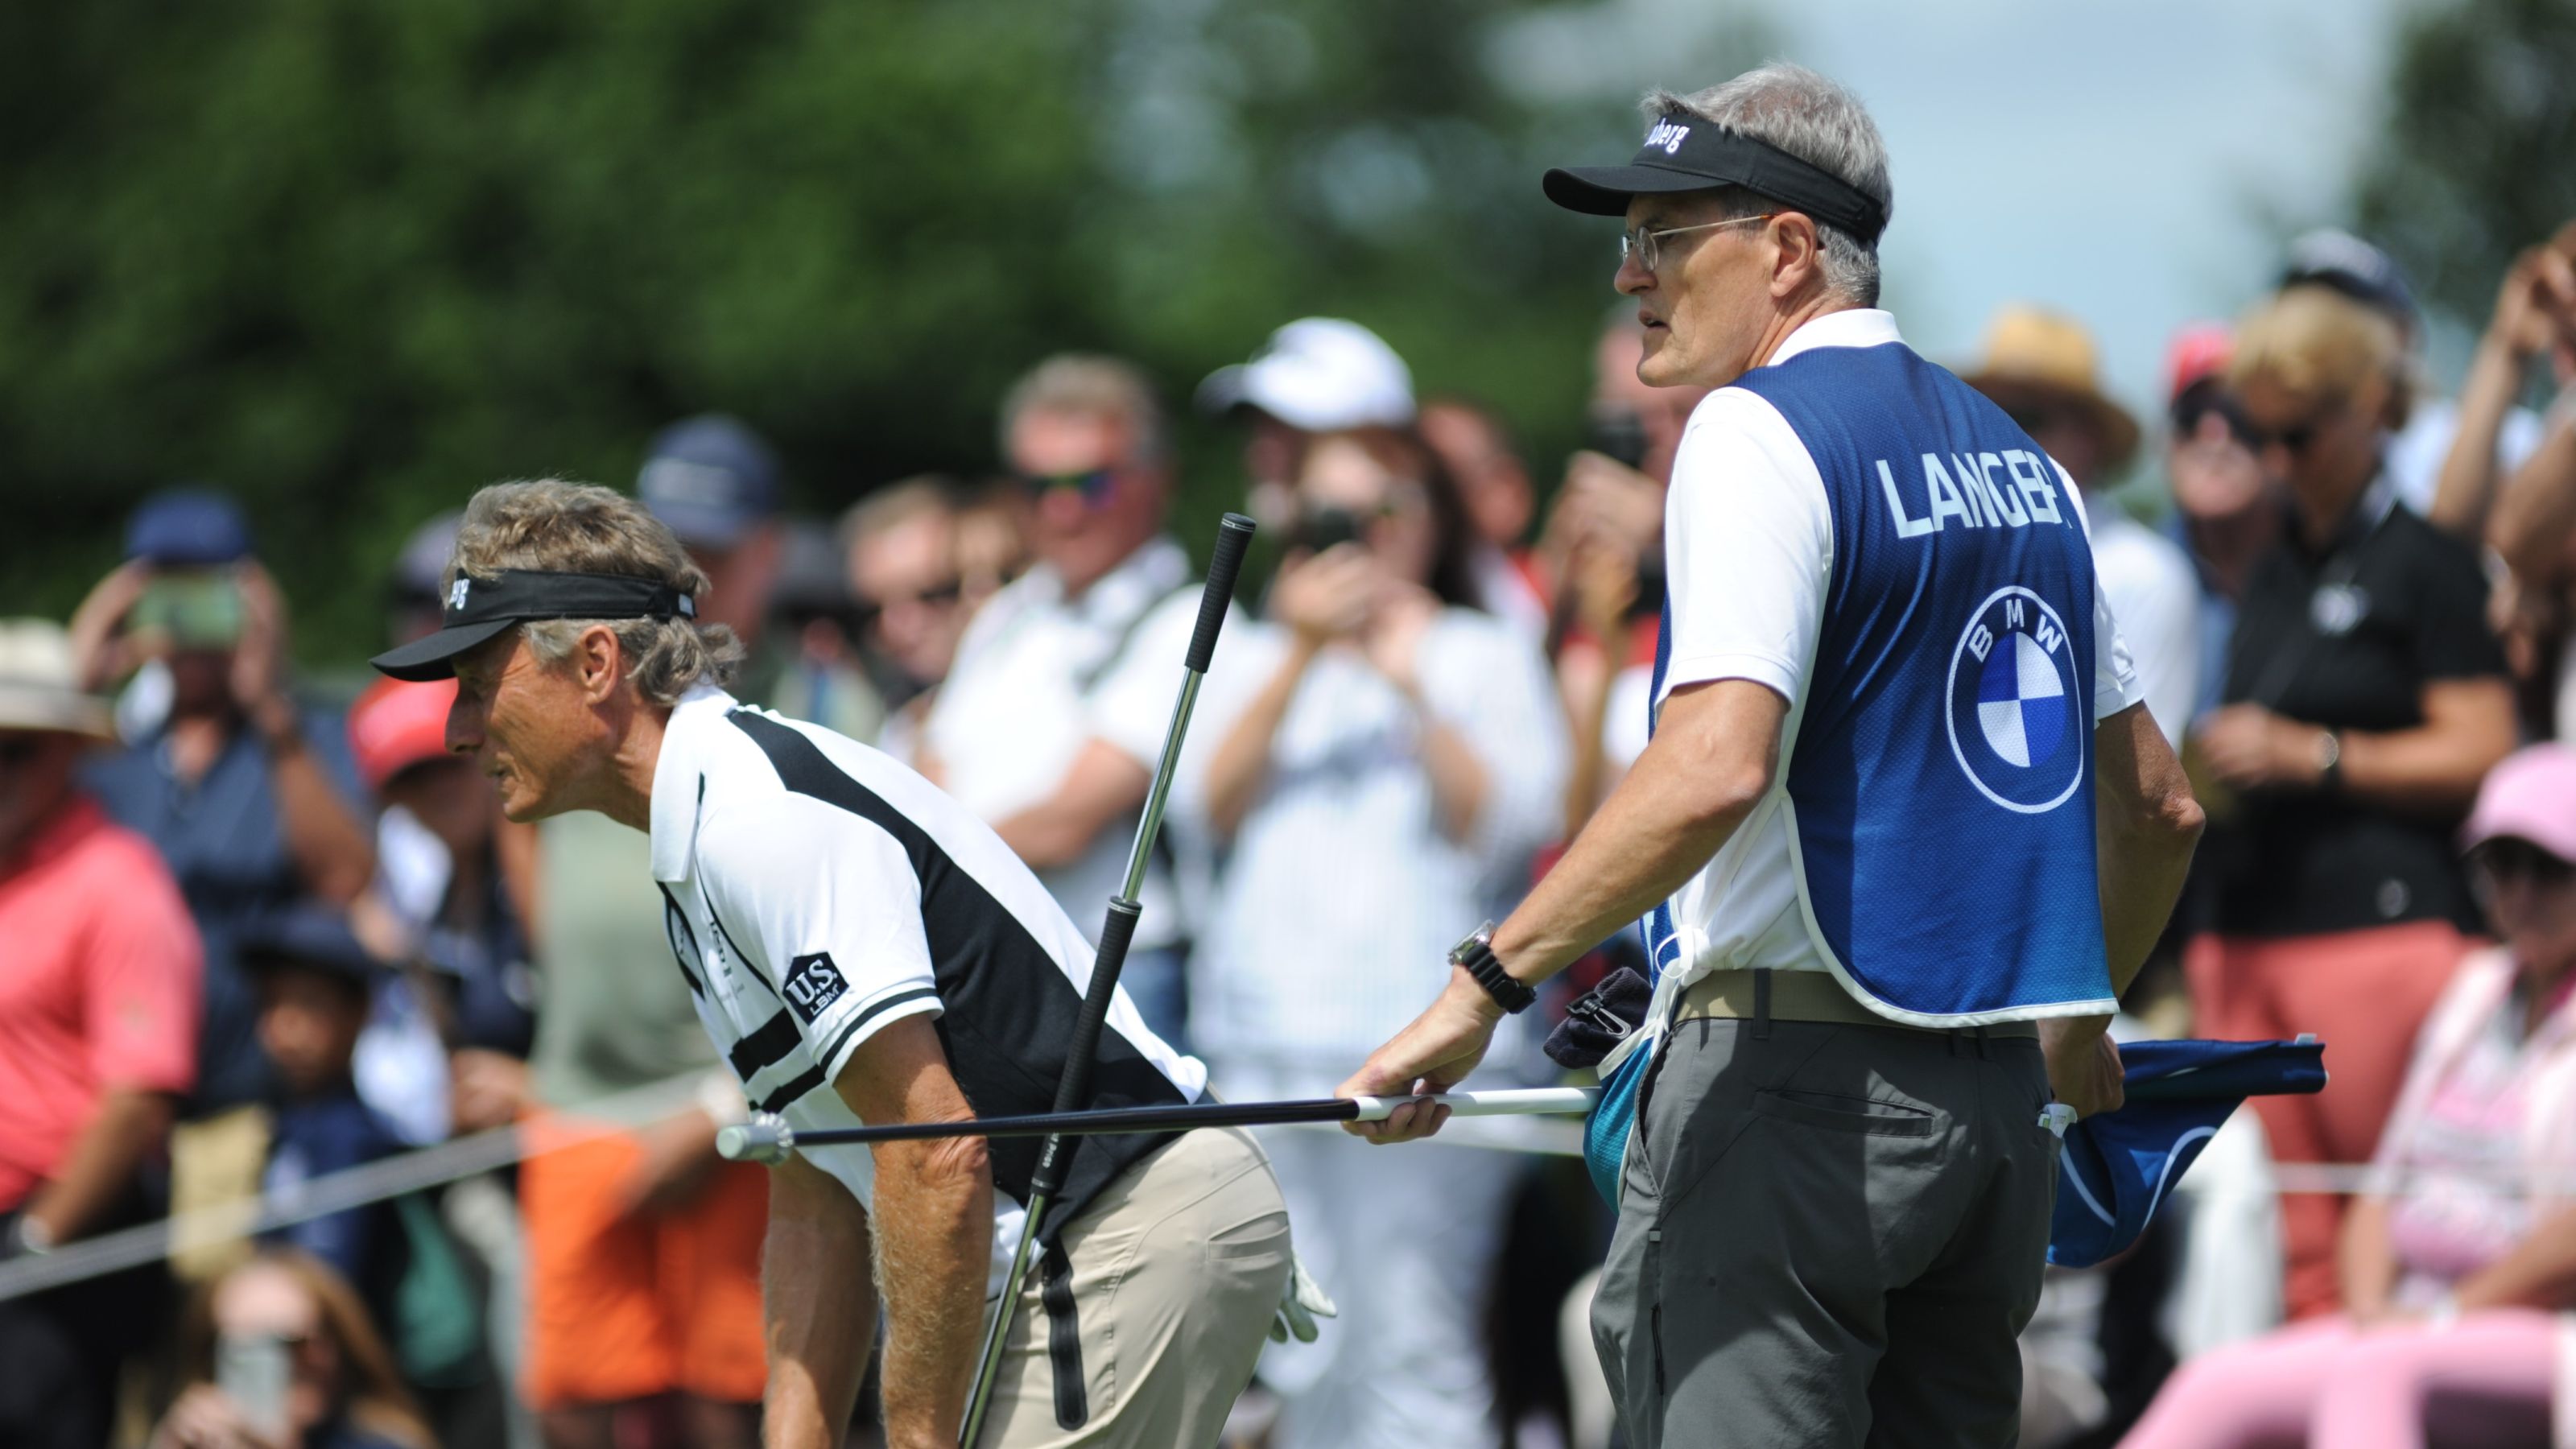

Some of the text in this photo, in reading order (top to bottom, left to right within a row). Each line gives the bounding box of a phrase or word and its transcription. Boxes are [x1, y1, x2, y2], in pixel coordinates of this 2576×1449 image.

[1968, 598, 2063, 663] BMW
[786, 959, 838, 1006] U.S.
[809, 983, 840, 1016] LBM
